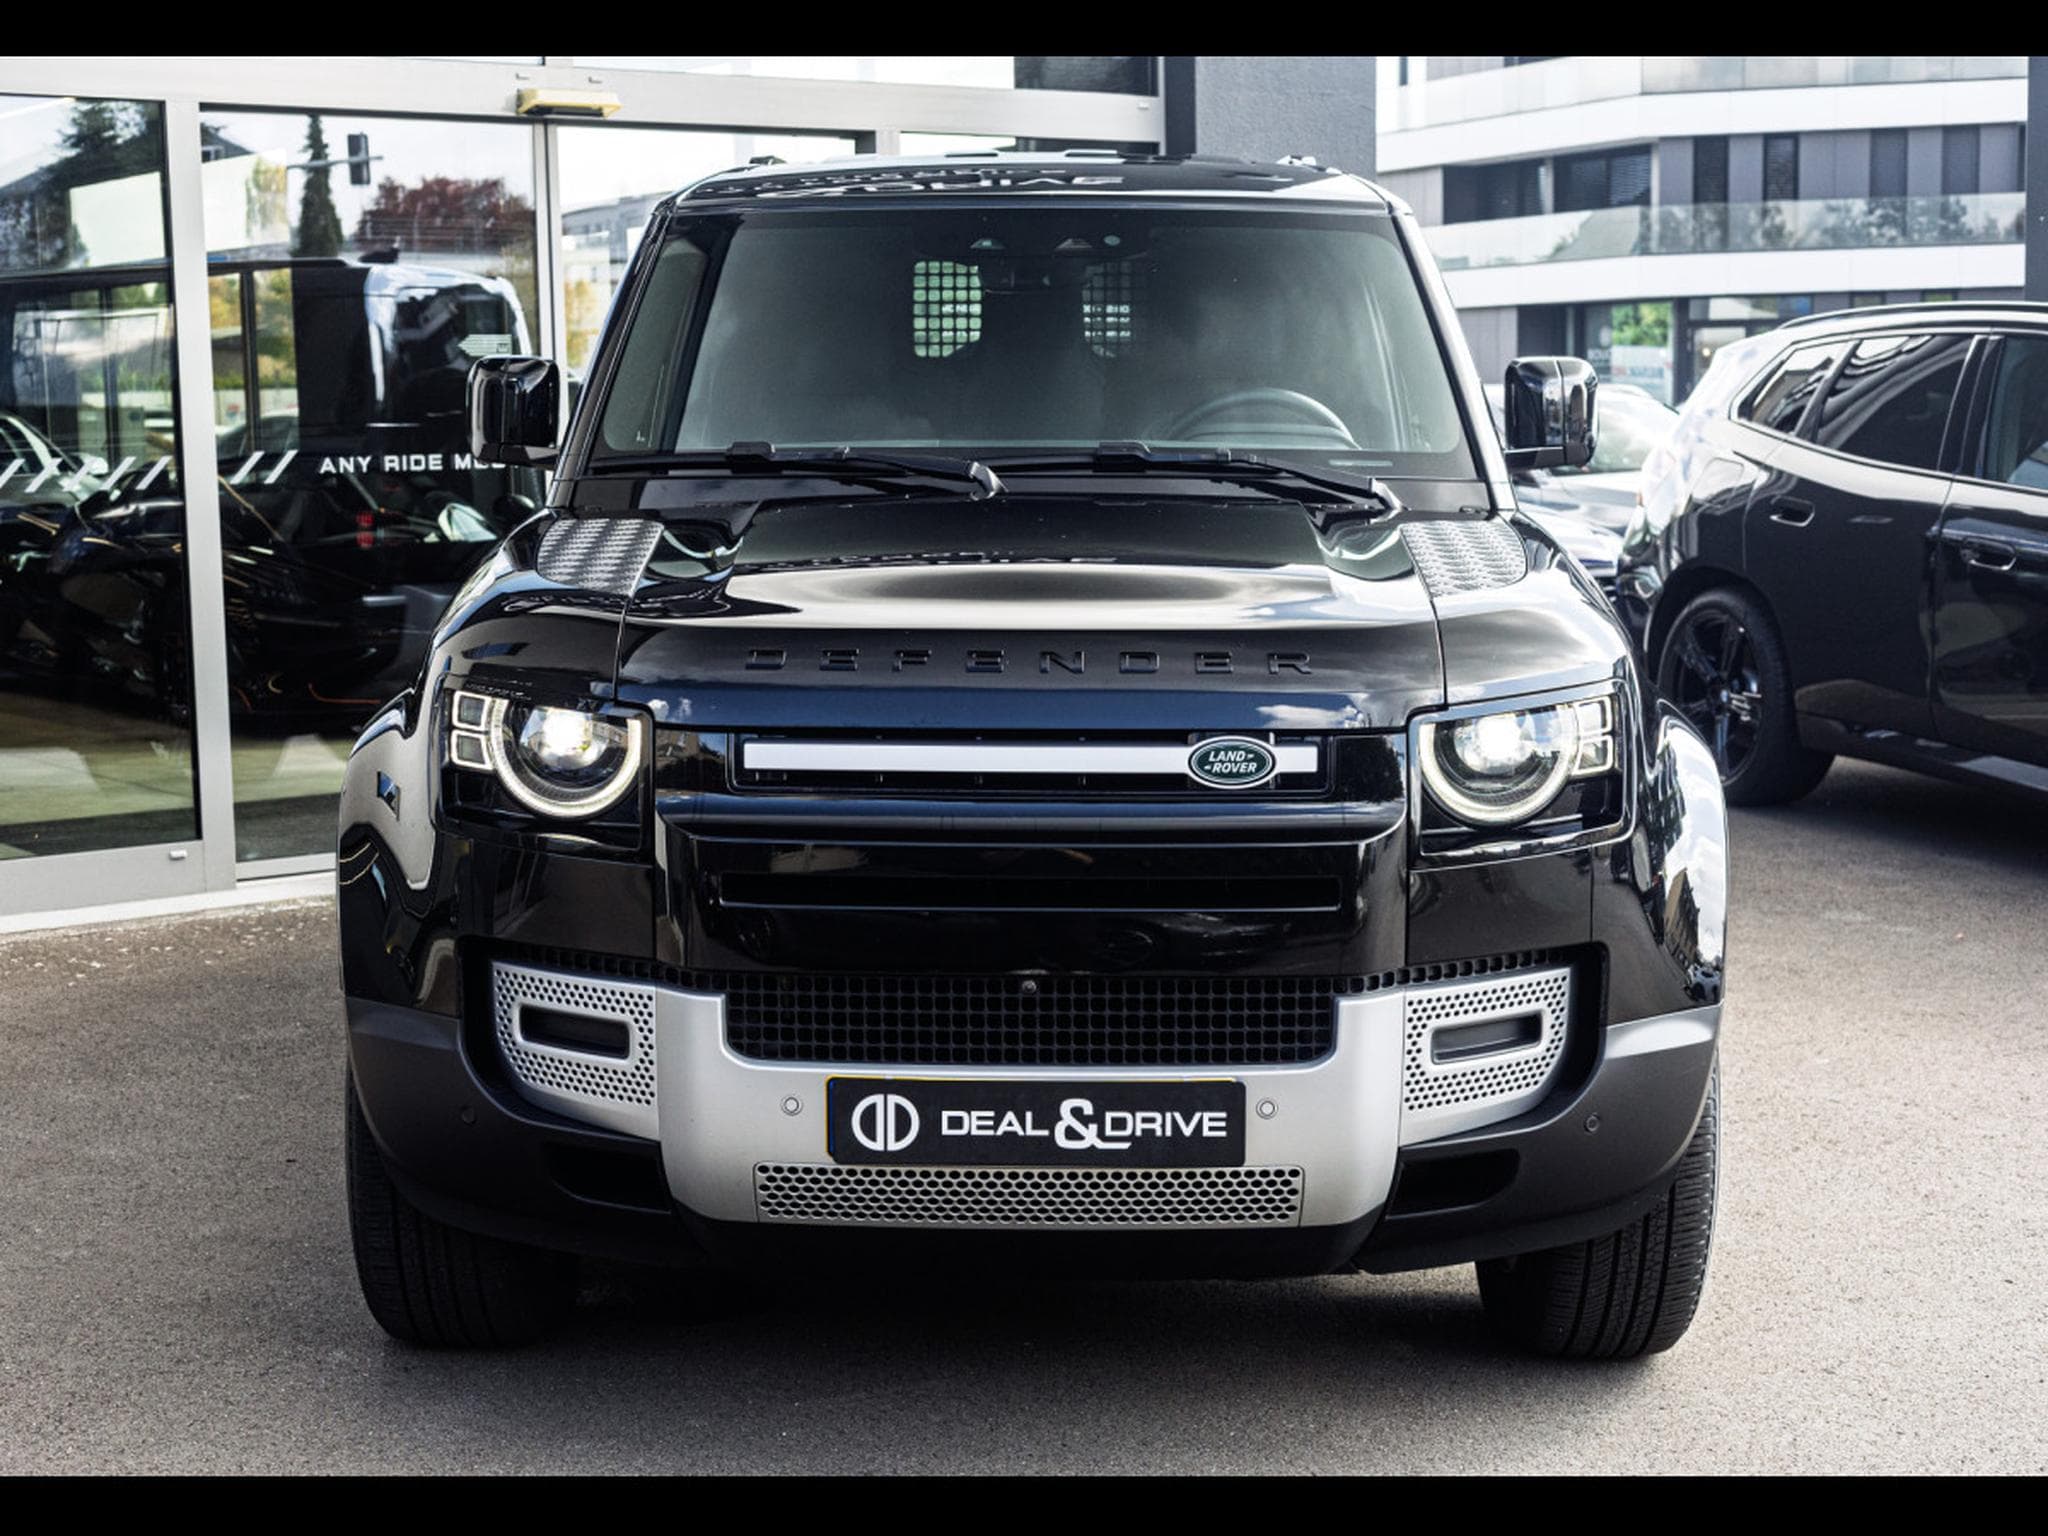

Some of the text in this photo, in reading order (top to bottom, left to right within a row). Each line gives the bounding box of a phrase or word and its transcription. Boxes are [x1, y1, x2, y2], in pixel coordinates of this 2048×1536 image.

[319, 454, 372, 474] ANY
[383, 453, 444, 472] RIDE
[745, 649, 1312, 675] DEFENDER
[1208, 750, 1247, 762] LAND
[1211, 762, 1258, 774] ROVER
